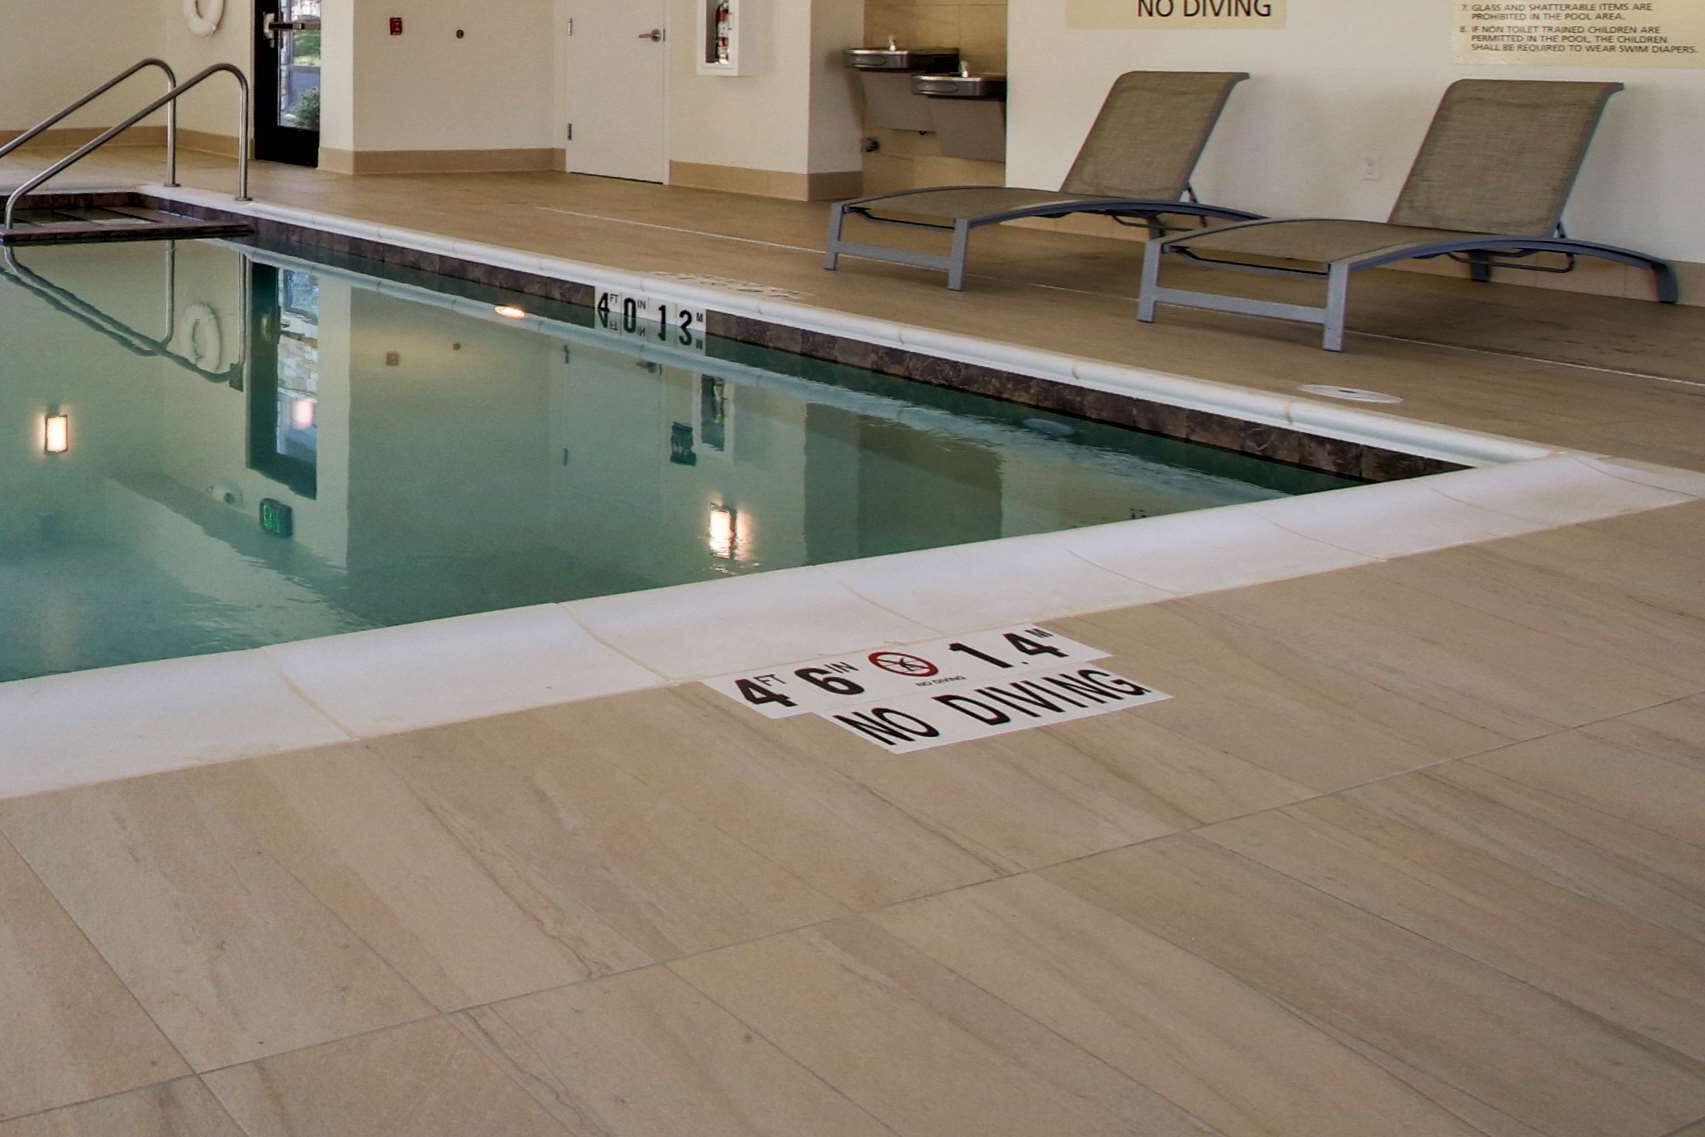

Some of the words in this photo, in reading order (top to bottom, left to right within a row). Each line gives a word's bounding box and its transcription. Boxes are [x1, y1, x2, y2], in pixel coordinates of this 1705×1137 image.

[1472, 4, 1502, 12] GLASS
[1528, 3, 1596, 12] SHATTERABLE
[1599, 3, 1629, 11] ITEMS
[1632, 3, 1653, 11] ARE
[1564, 13, 1592, 21] POOL
[1472, 25, 1481, 33] IF
[1482, 25, 1504, 33] NON
[1542, 26, 1585, 34] TRAINED
[1588, 26, 1637, 34] CHILDREN
[1640, 26, 1661, 34] ARE
[1595, 35, 1615, 43] THE
[1517, 44, 1566, 52] REQUIRED
[1619, 45, 1648, 53] SWIM
[832, 707, 940, 745] NO
[931, 669, 1153, 726] DIVING
